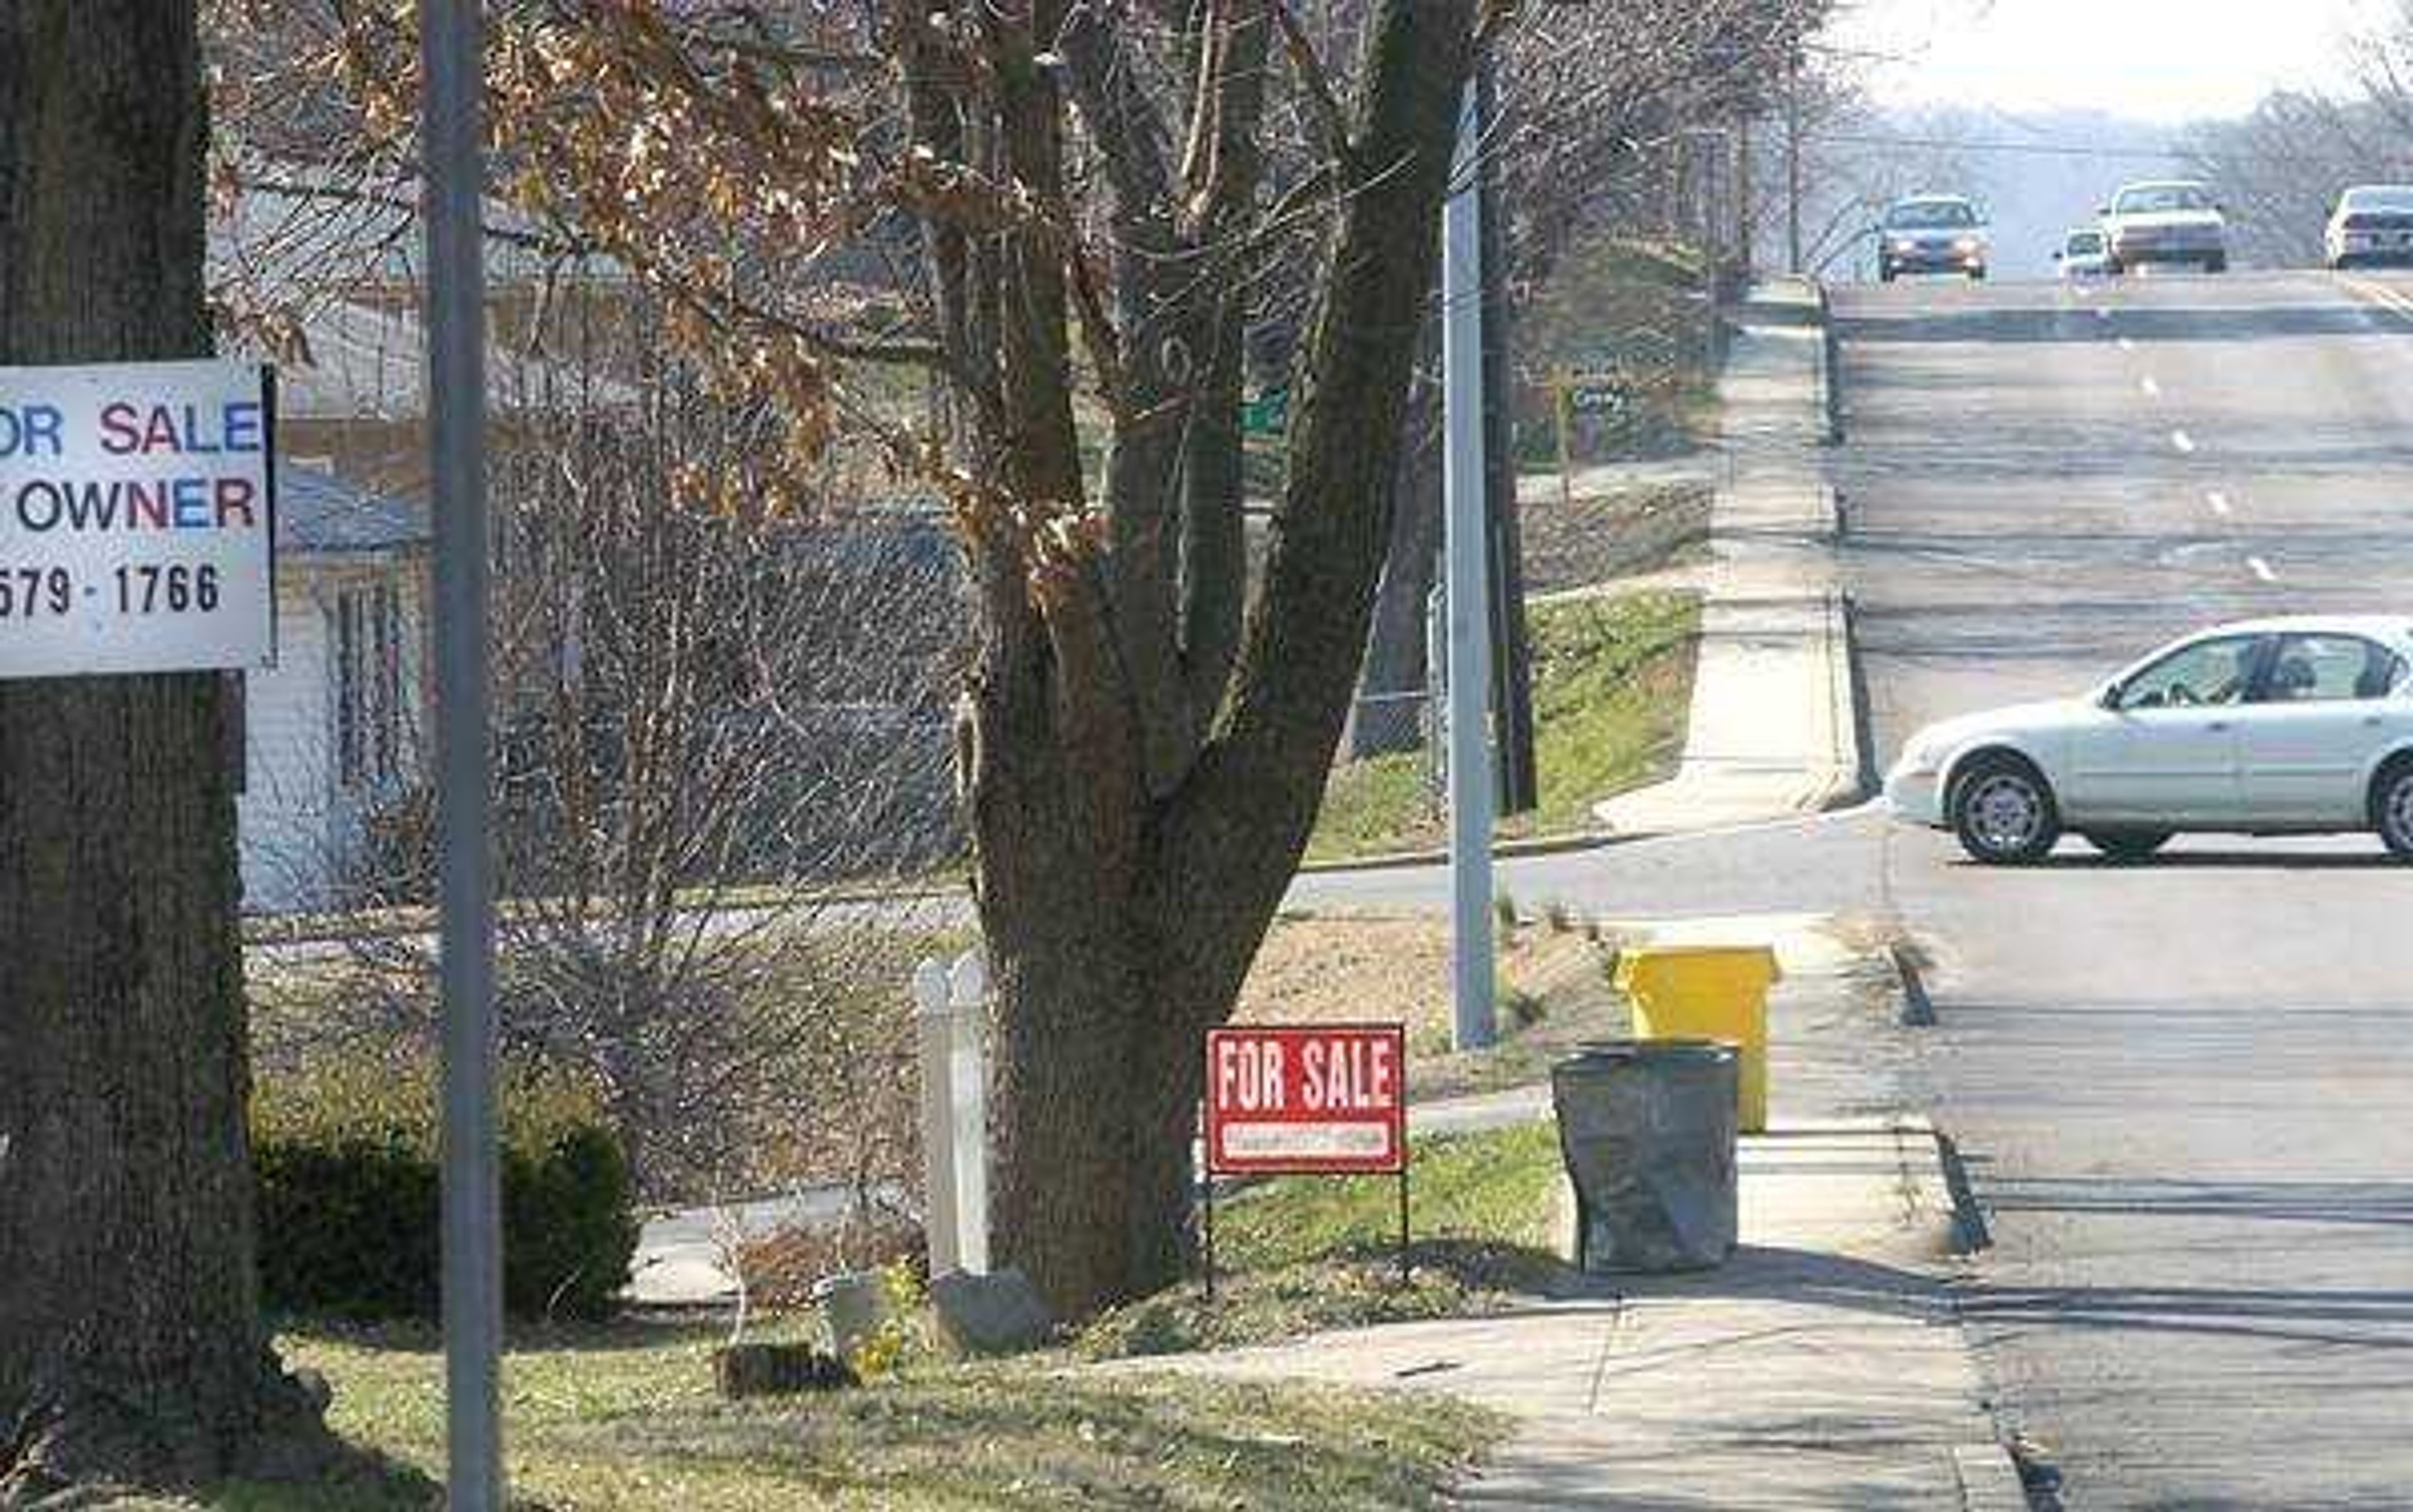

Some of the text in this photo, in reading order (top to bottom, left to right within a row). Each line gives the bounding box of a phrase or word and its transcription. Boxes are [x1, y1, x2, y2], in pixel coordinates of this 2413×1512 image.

[100, 402, 261, 454] SALE
[17, 478, 255, 532] OWNER
[1218, 1039, 1392, 1110] FOR SALE
